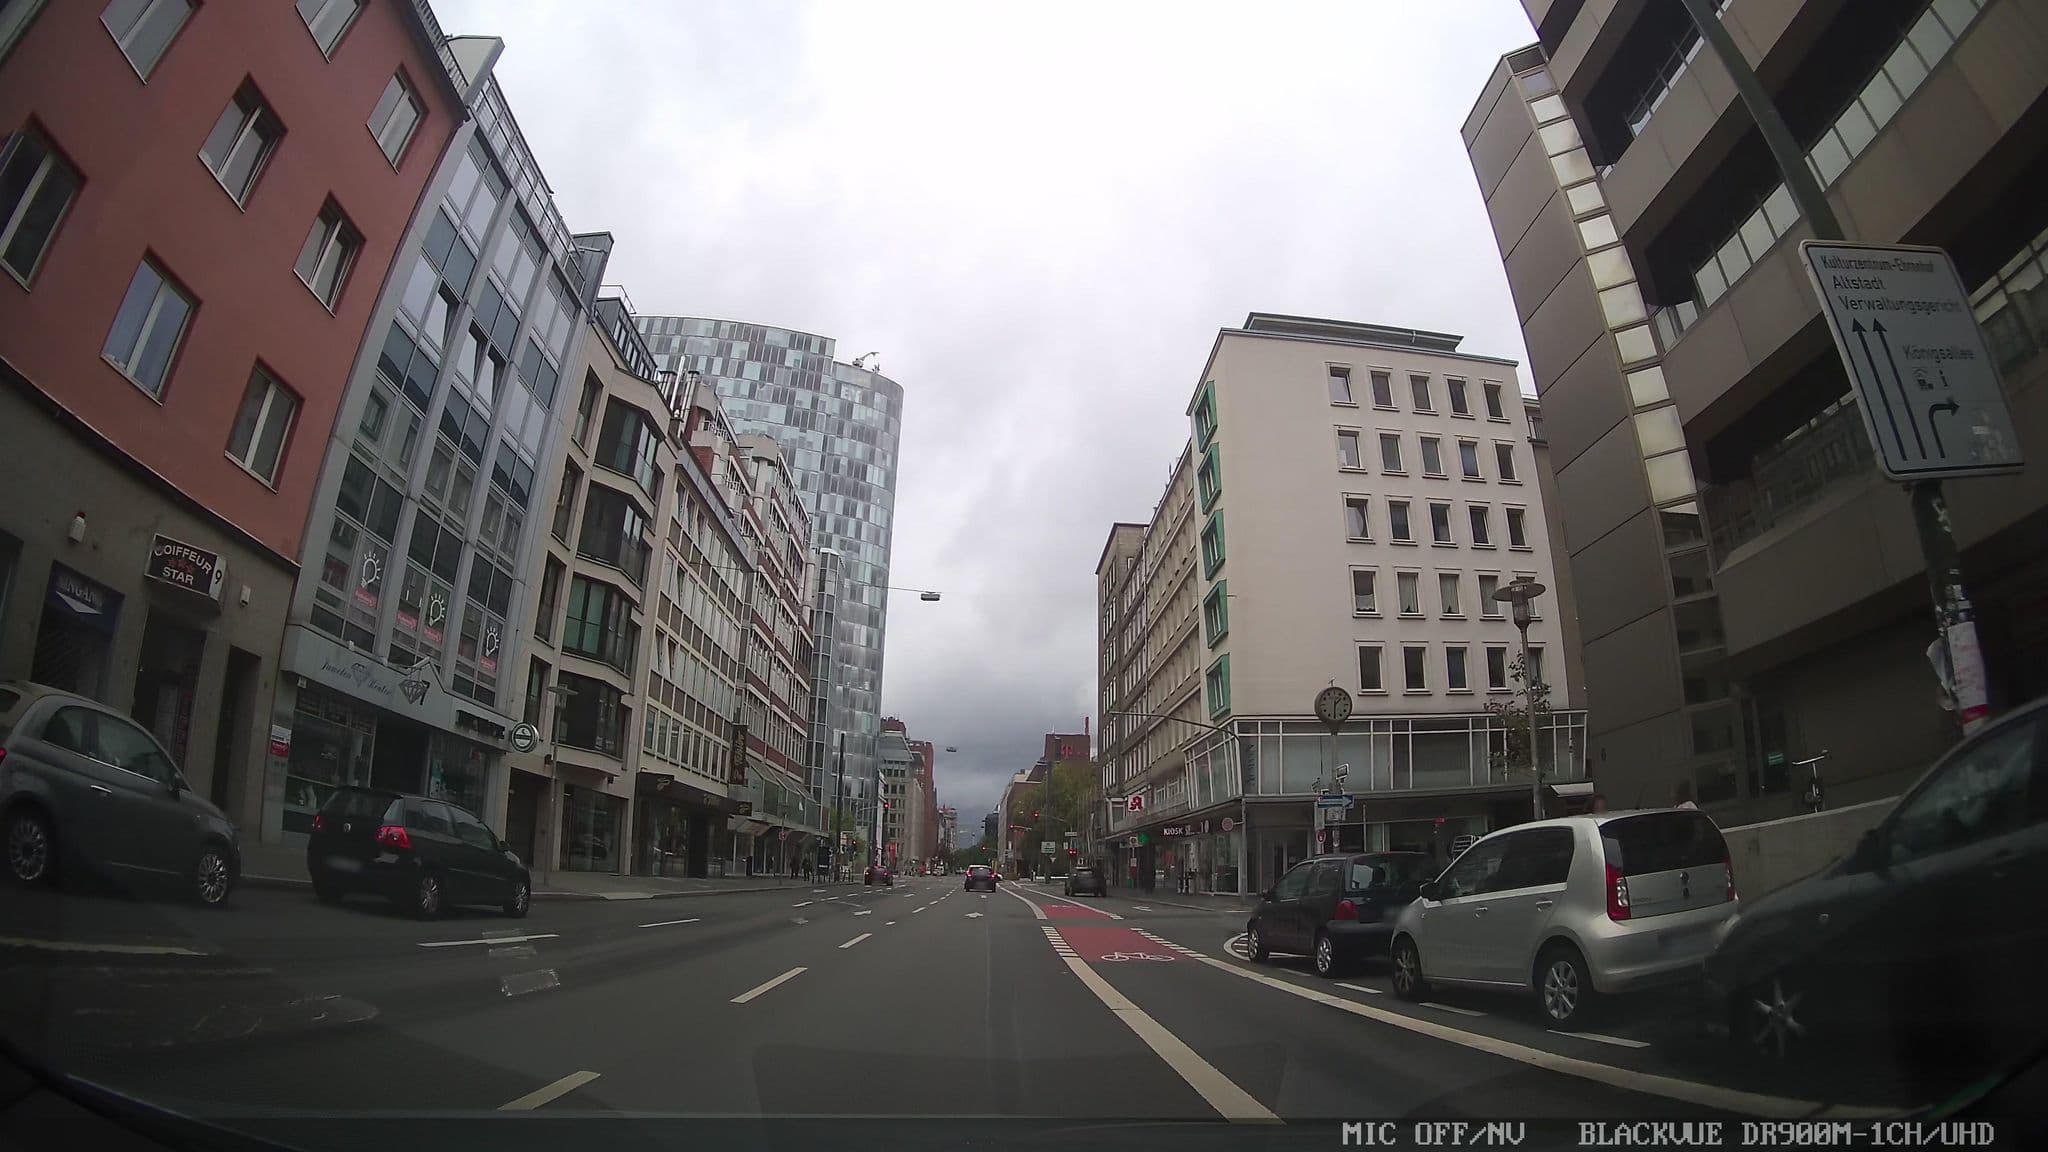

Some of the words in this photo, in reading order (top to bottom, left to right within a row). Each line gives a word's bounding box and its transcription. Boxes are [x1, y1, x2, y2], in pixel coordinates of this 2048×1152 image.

[1832, 275, 1886, 290] Altstadt
[1838, 295, 1962, 315] Verwaltungsgericht
[162, 566, 194, 585] STAR
[215, 569, 223, 584] 9
[1163, 826, 1183, 836] KIOSK
